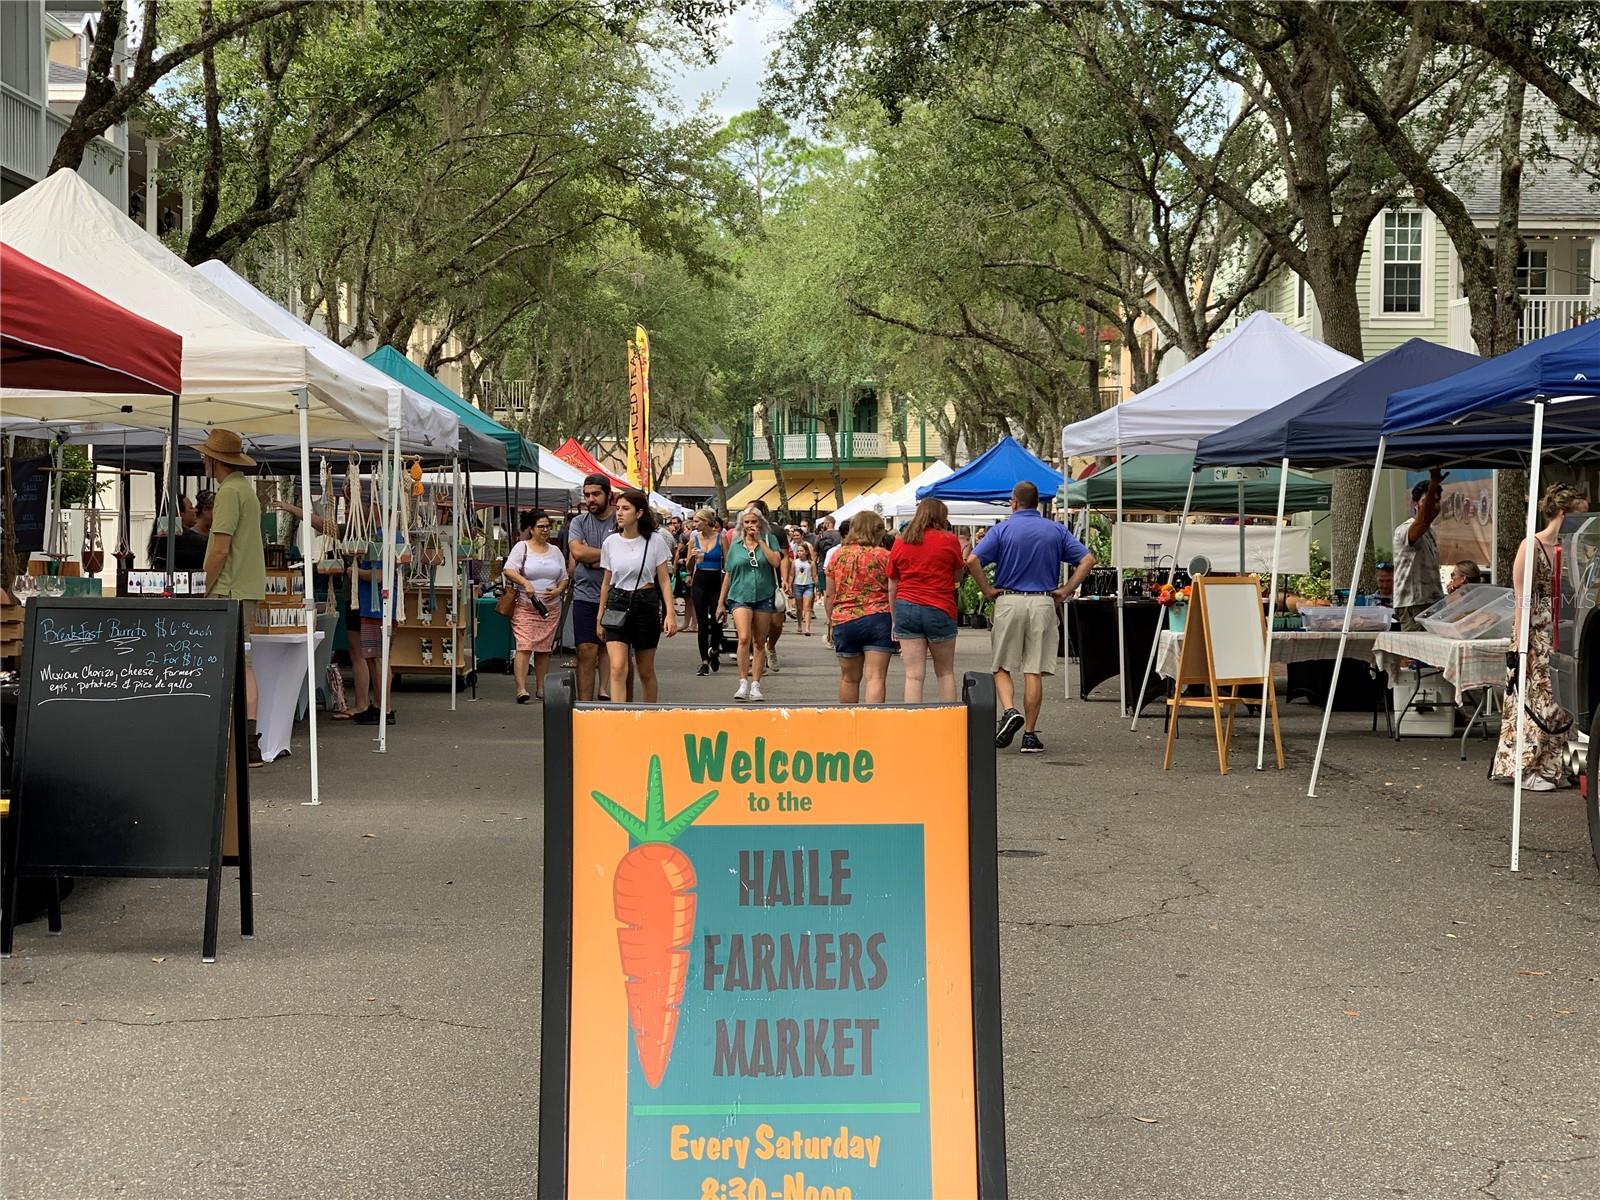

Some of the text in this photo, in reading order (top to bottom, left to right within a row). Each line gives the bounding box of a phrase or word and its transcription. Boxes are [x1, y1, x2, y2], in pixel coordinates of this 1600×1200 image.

[629, 355, 638, 390] TEA
[631, 393, 639, 431] ICED
[106, 617, 147, 638] Burrito
[40, 663, 79, 682] Mexican
[145, 651, 160, 667] 2
[167, 677, 194, 695] gallo
[683, 730, 875, 785] Welcome
[747, 791, 813, 812] to the
[738, 849, 852, 907] HAILE
[703, 932, 888, 992] FARMERS
[712, 1017, 881, 1078] MARKET
[669, 1123, 881, 1169] Every Saturday
